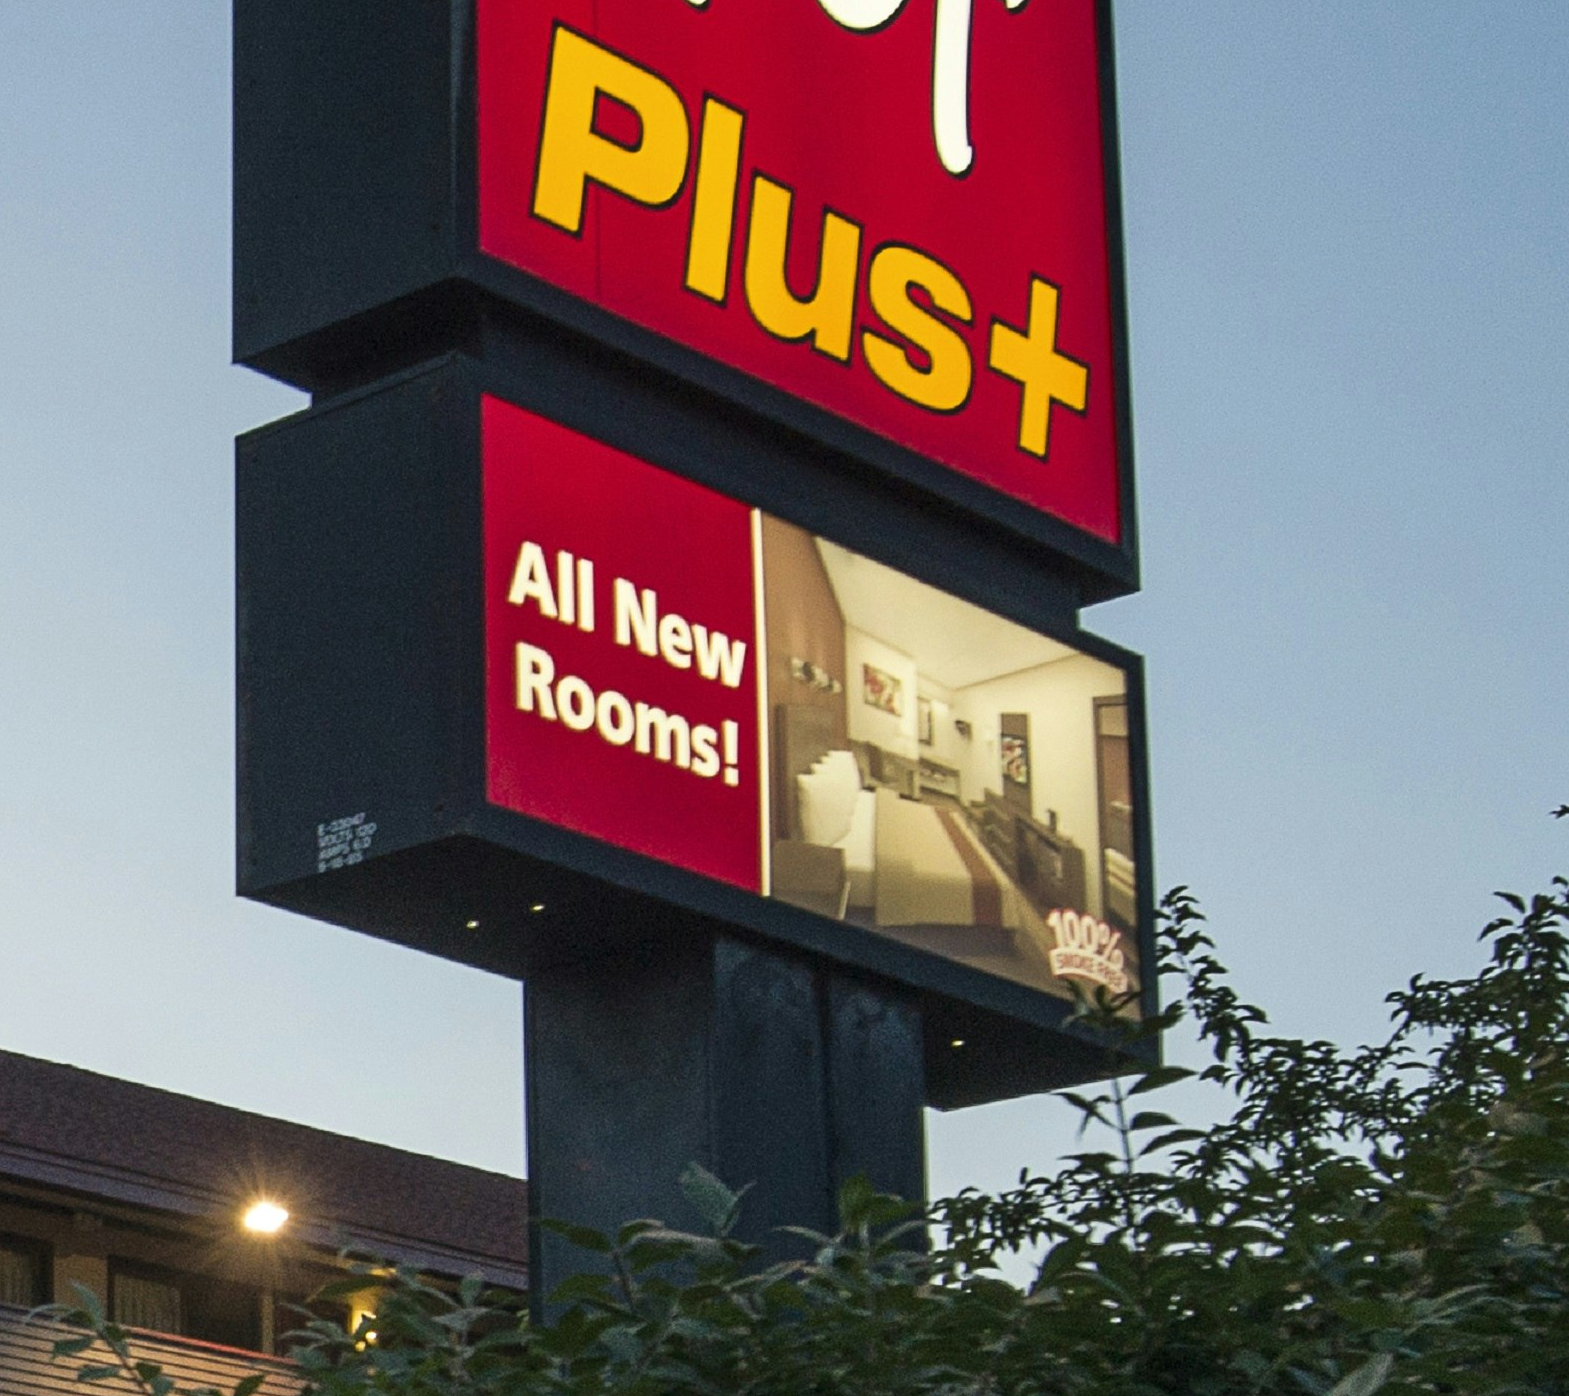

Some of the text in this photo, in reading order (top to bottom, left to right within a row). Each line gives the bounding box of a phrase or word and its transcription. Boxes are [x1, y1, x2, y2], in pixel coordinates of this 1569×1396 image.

[531, 24, 1089, 458] Plus+
[508, 540, 747, 688] All New
[516, 641, 739, 787] Rooms!
[1047, 908, 1124, 970] 100%
